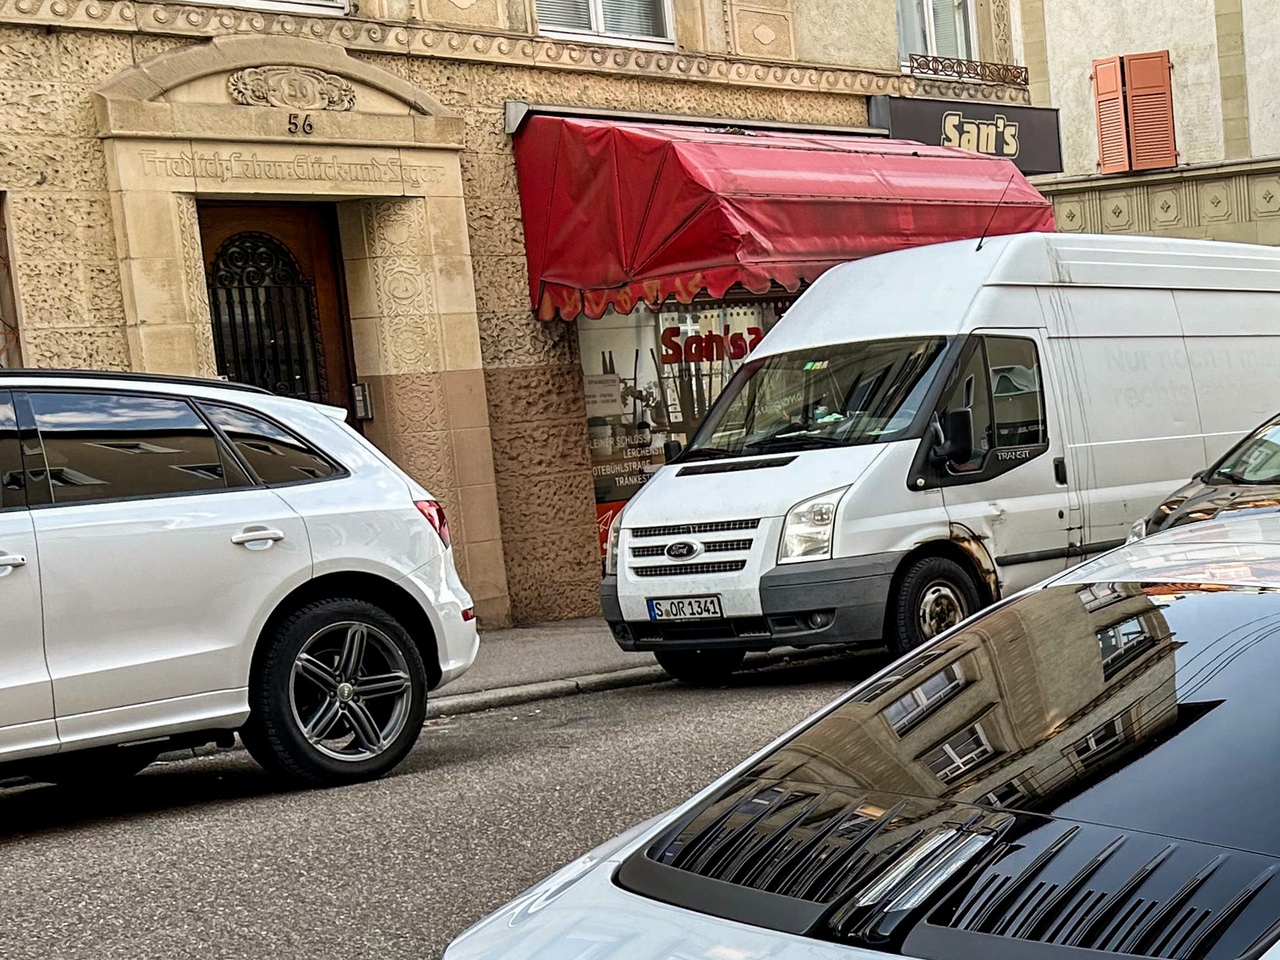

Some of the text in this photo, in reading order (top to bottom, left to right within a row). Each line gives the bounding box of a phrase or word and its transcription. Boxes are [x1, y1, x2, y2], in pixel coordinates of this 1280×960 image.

[287, 113, 315, 135] 56
[942, 112, 1018, 156] San's
[589, 437, 615, 449] LEINER
[997, 450, 1030, 460] TRANSIT
[654, 599, 719, 618] S OR 1341
